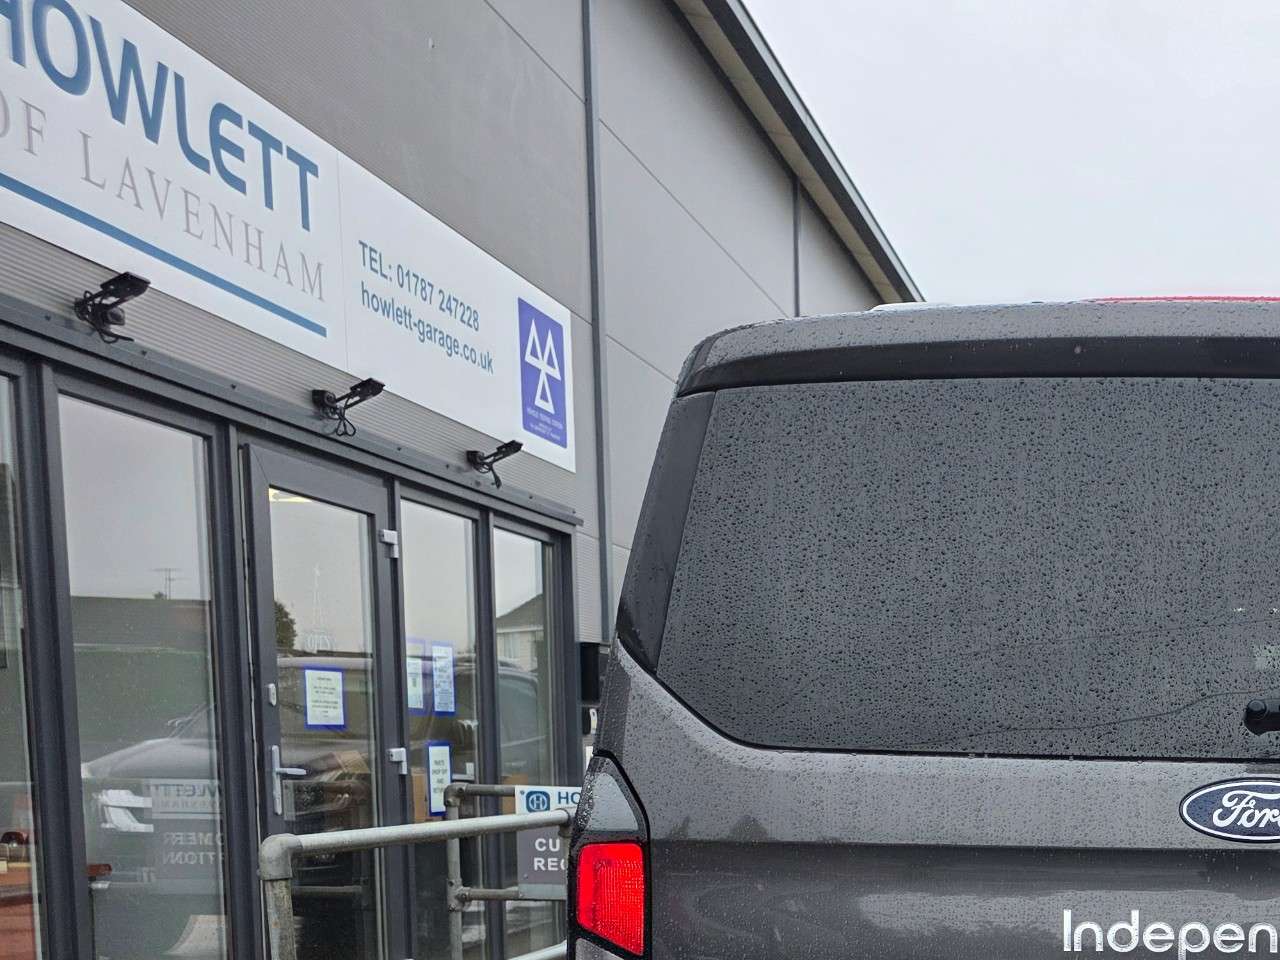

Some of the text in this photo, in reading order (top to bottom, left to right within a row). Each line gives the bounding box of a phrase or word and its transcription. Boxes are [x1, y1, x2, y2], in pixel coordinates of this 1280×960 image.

[78, 129, 326, 302] LAVENHAM
[358, 239, 480, 332] TEL: 01787 247228
[360, 280, 495, 375] howlett-garage.co.uk
